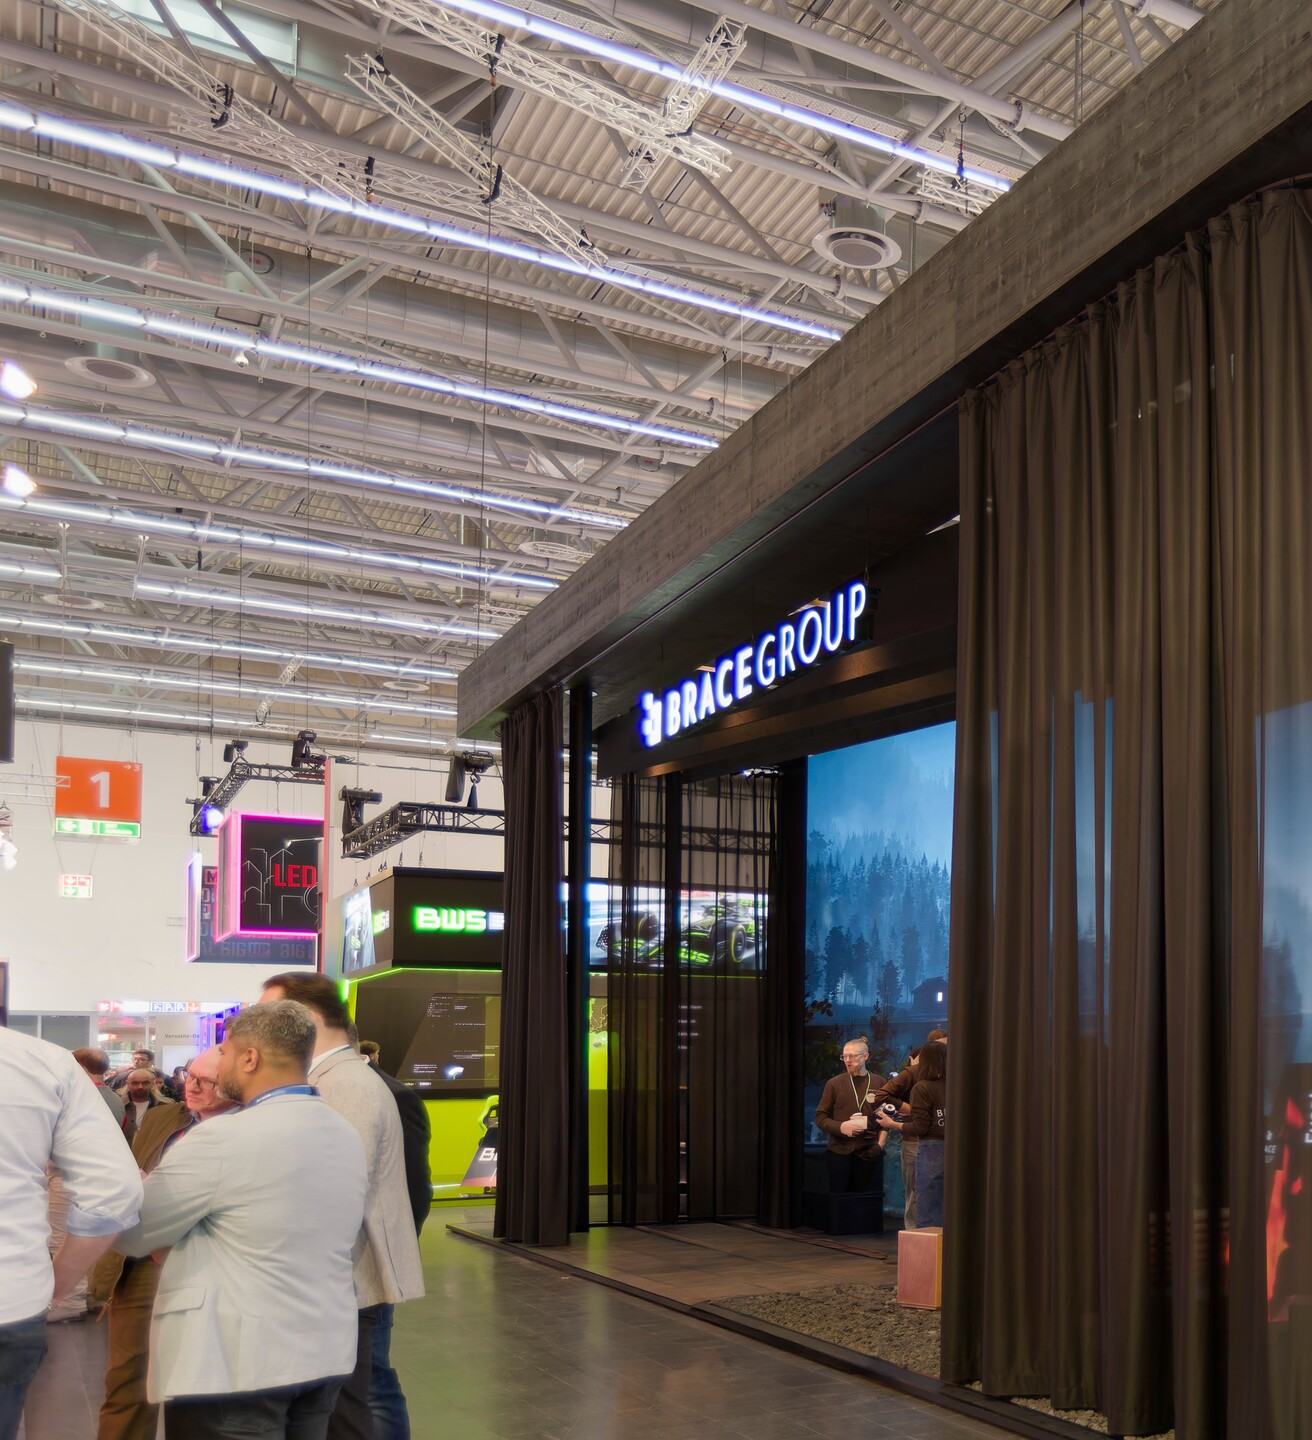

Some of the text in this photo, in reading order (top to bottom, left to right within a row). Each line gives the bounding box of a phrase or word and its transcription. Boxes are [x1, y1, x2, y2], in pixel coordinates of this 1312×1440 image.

[133, 764, 141, 772] 3
[90, 771, 110, 809] 1
[273, 863, 317, 888] LED
[413, 906, 487, 933] BWS
